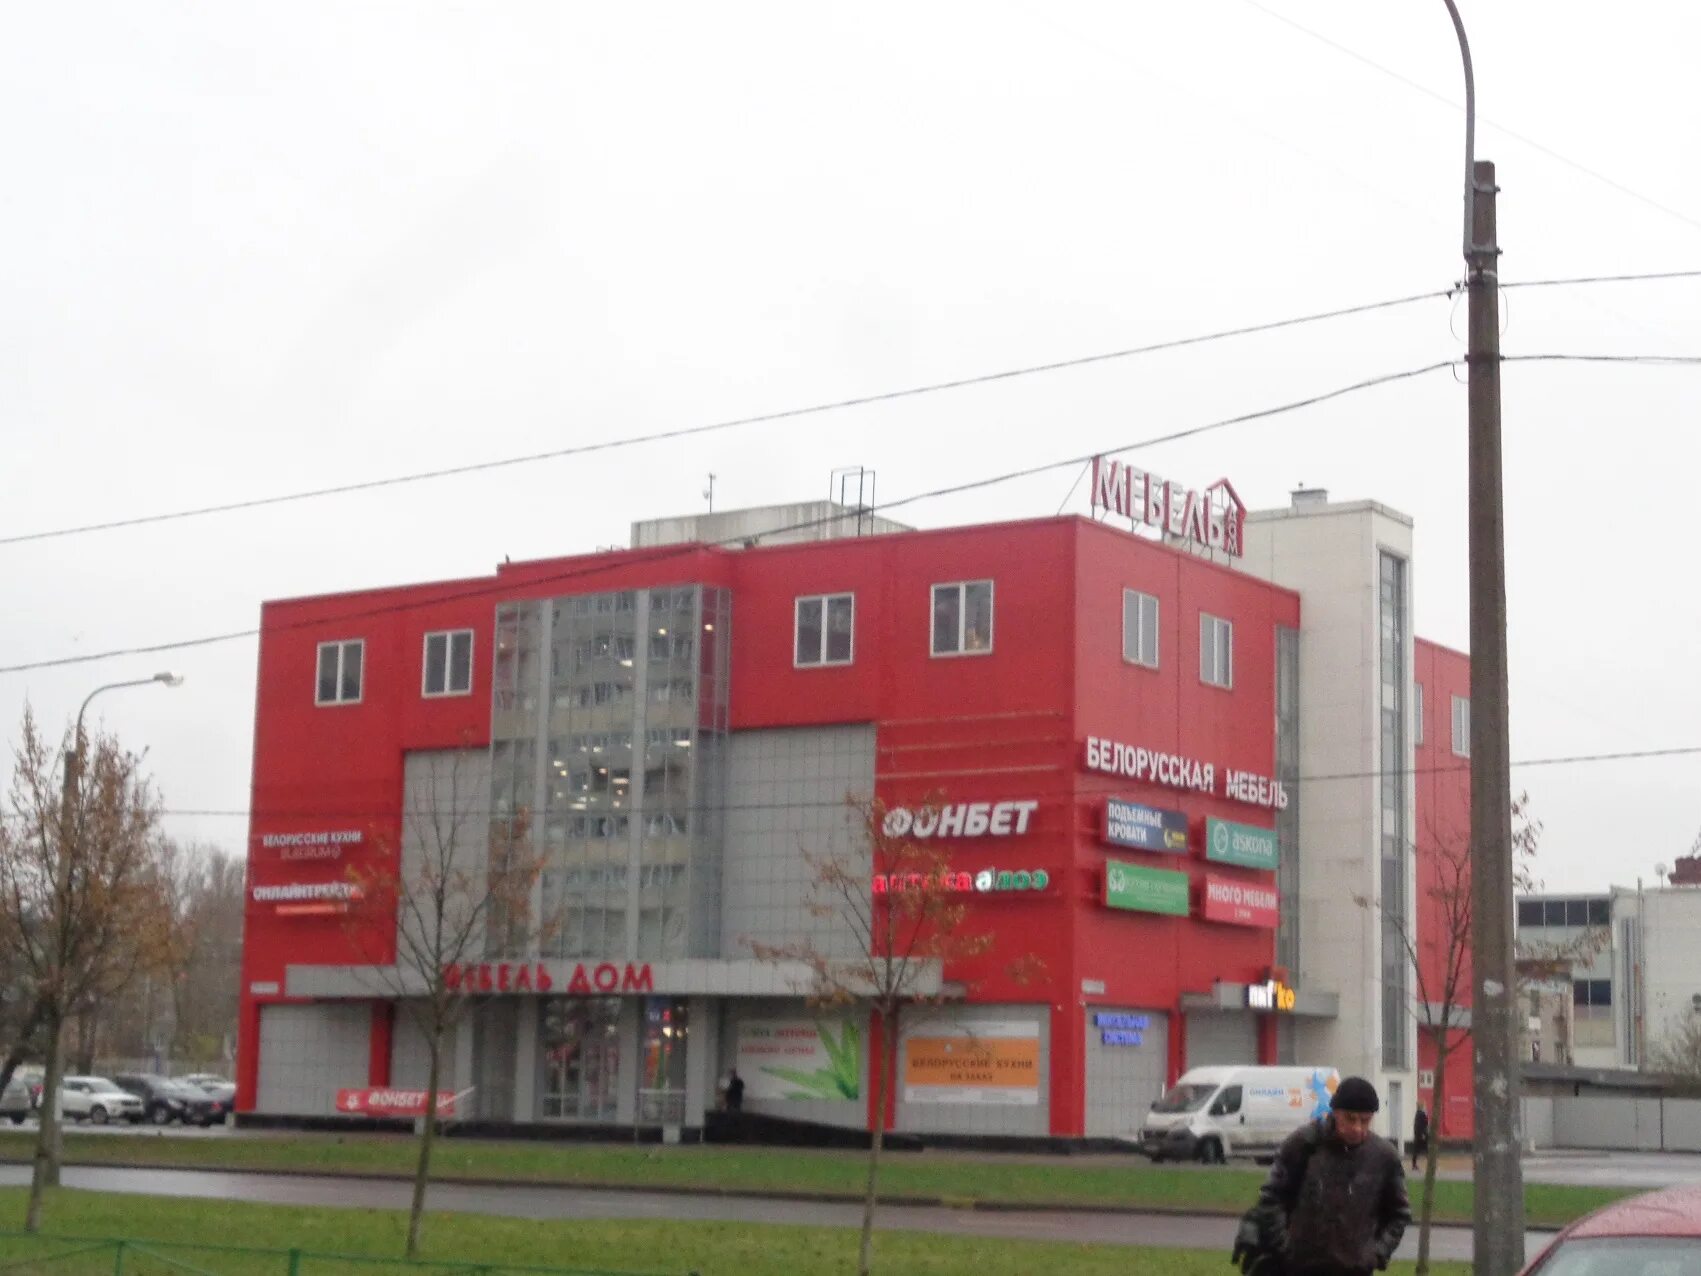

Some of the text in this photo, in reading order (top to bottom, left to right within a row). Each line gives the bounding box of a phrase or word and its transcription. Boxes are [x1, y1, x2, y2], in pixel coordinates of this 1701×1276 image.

[1091, 454, 1225, 549] МЕБЕЛЬ
[1086, 735, 1289, 809] БЕЛОРУССКАЯ МЕБЕЛЬ
[882, 801, 1039, 838] ФОНБЕТ
[331, 830, 362, 843] КУХНИ
[1232, 834, 1273, 857] askona
[1208, 882, 1242, 905] МНОГО
[1243, 888, 1277, 910] МЕБЕЛИ
[567, 962, 654, 994] ДОМ
